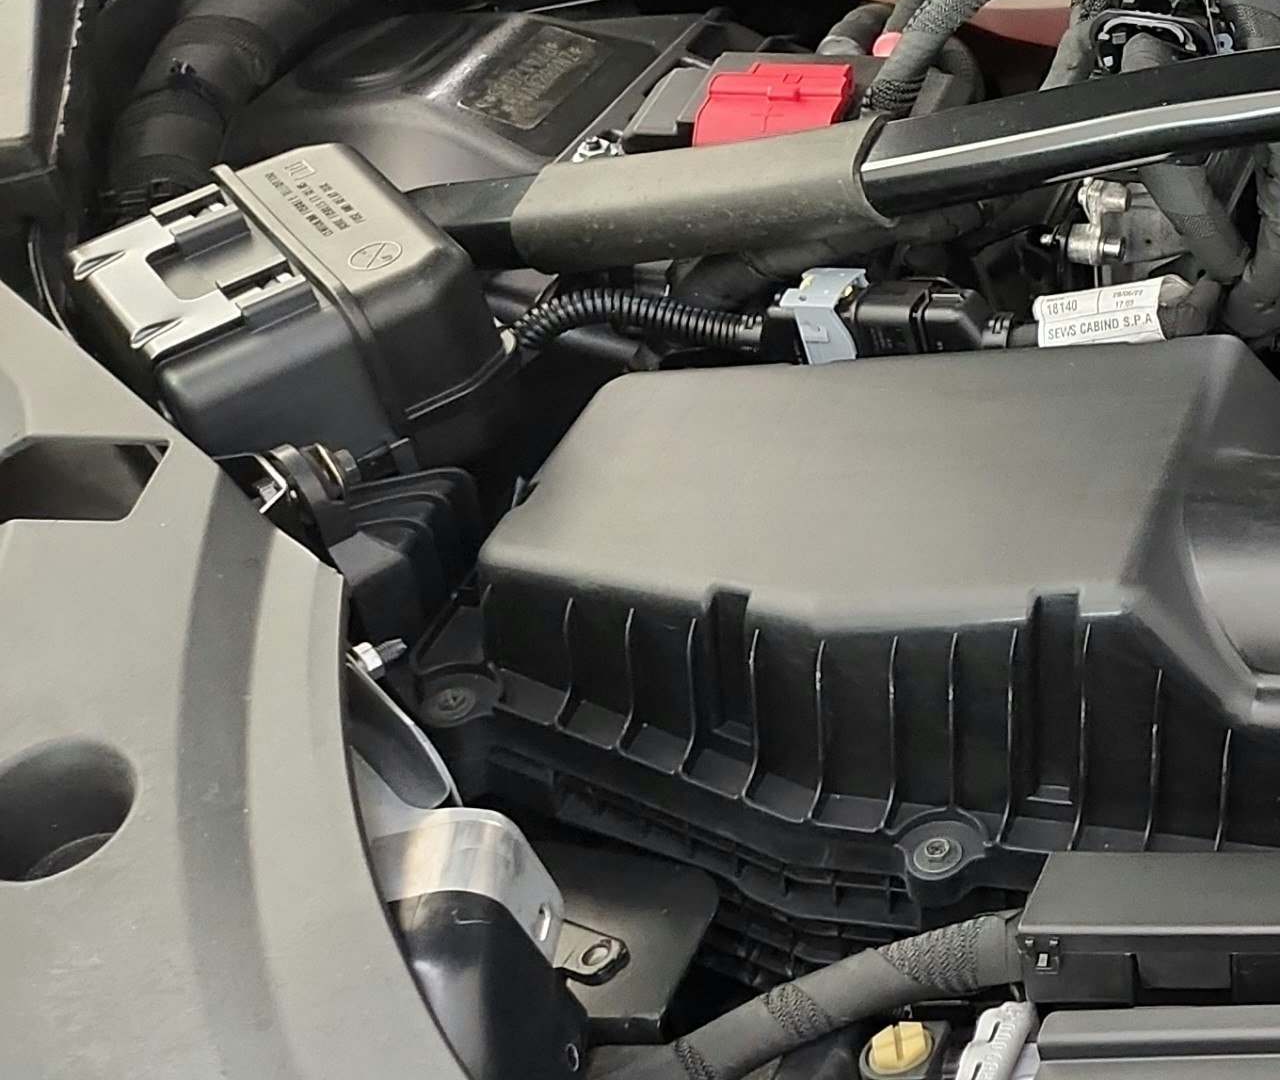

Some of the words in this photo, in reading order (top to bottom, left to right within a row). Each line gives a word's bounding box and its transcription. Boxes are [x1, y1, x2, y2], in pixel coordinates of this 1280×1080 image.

[1047, 300, 1077, 315] 18140
[1048, 325, 1076, 340] SEWS
[1080, 319, 1119, 334] CABIND
